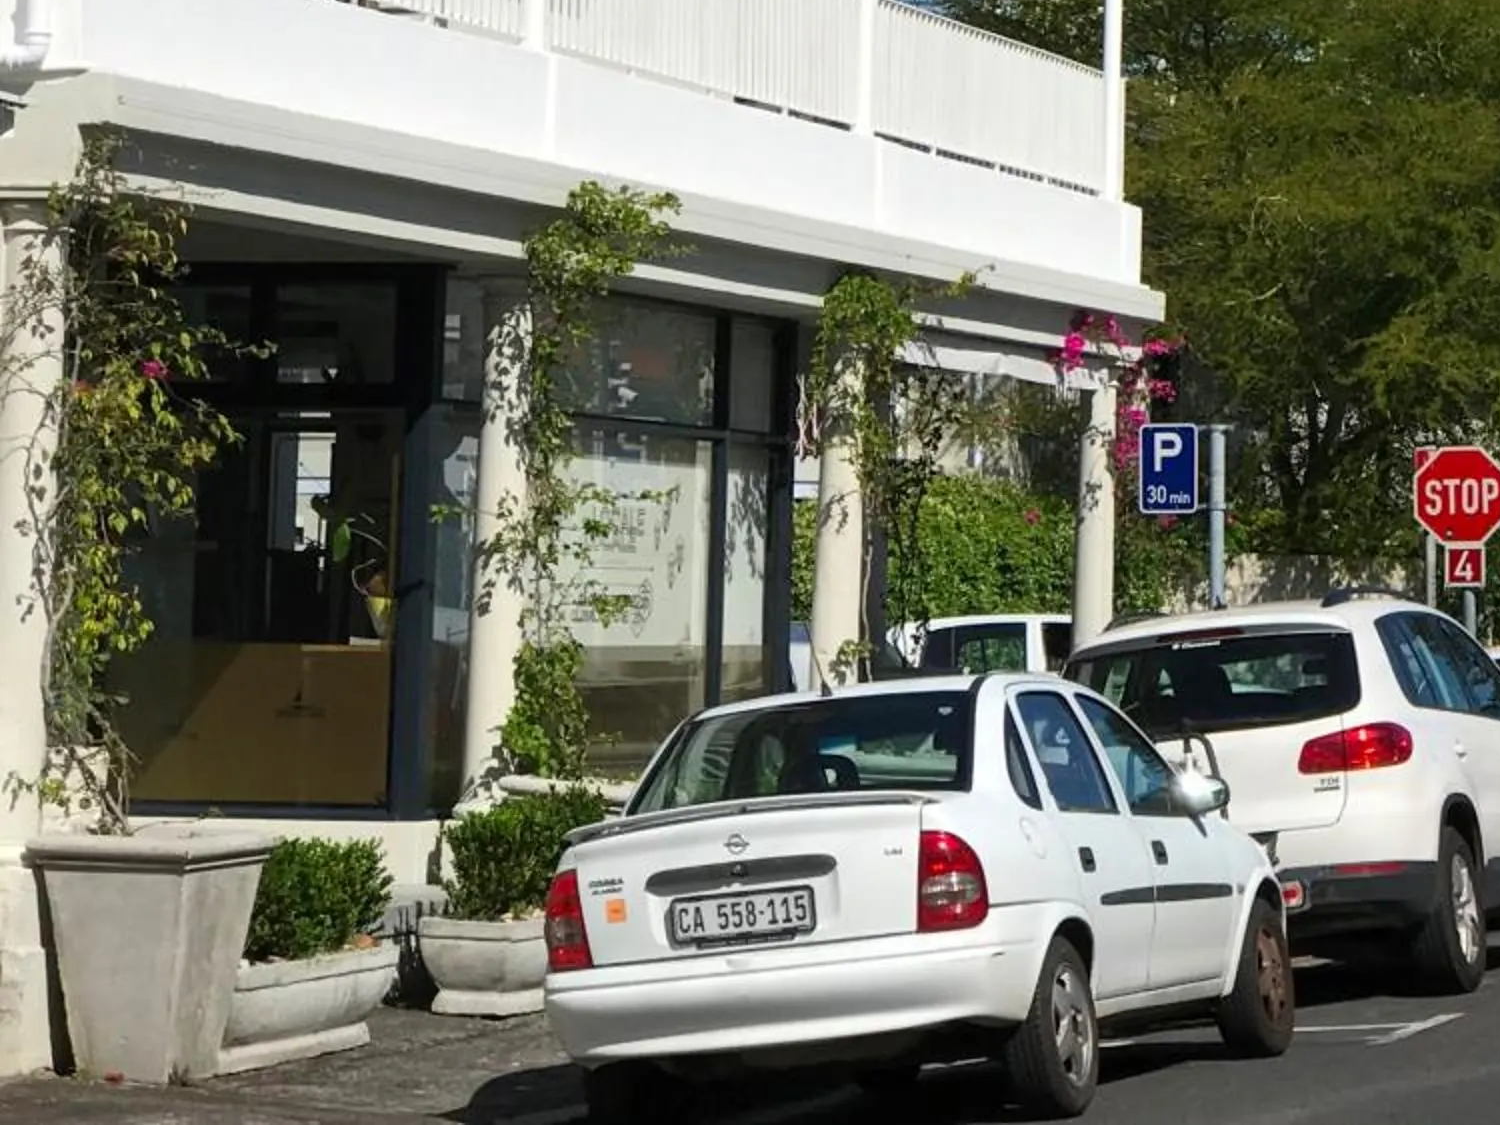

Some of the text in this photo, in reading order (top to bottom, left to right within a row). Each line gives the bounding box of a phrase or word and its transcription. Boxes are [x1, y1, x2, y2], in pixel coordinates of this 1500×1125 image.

[1153, 432, 1183, 472] P
[1146, 485, 1191, 504] 30 min
[1423, 478, 1500, 516] STOP
[1453, 550, 1474, 582] 4
[679, 895, 807, 933] CA 558-115
